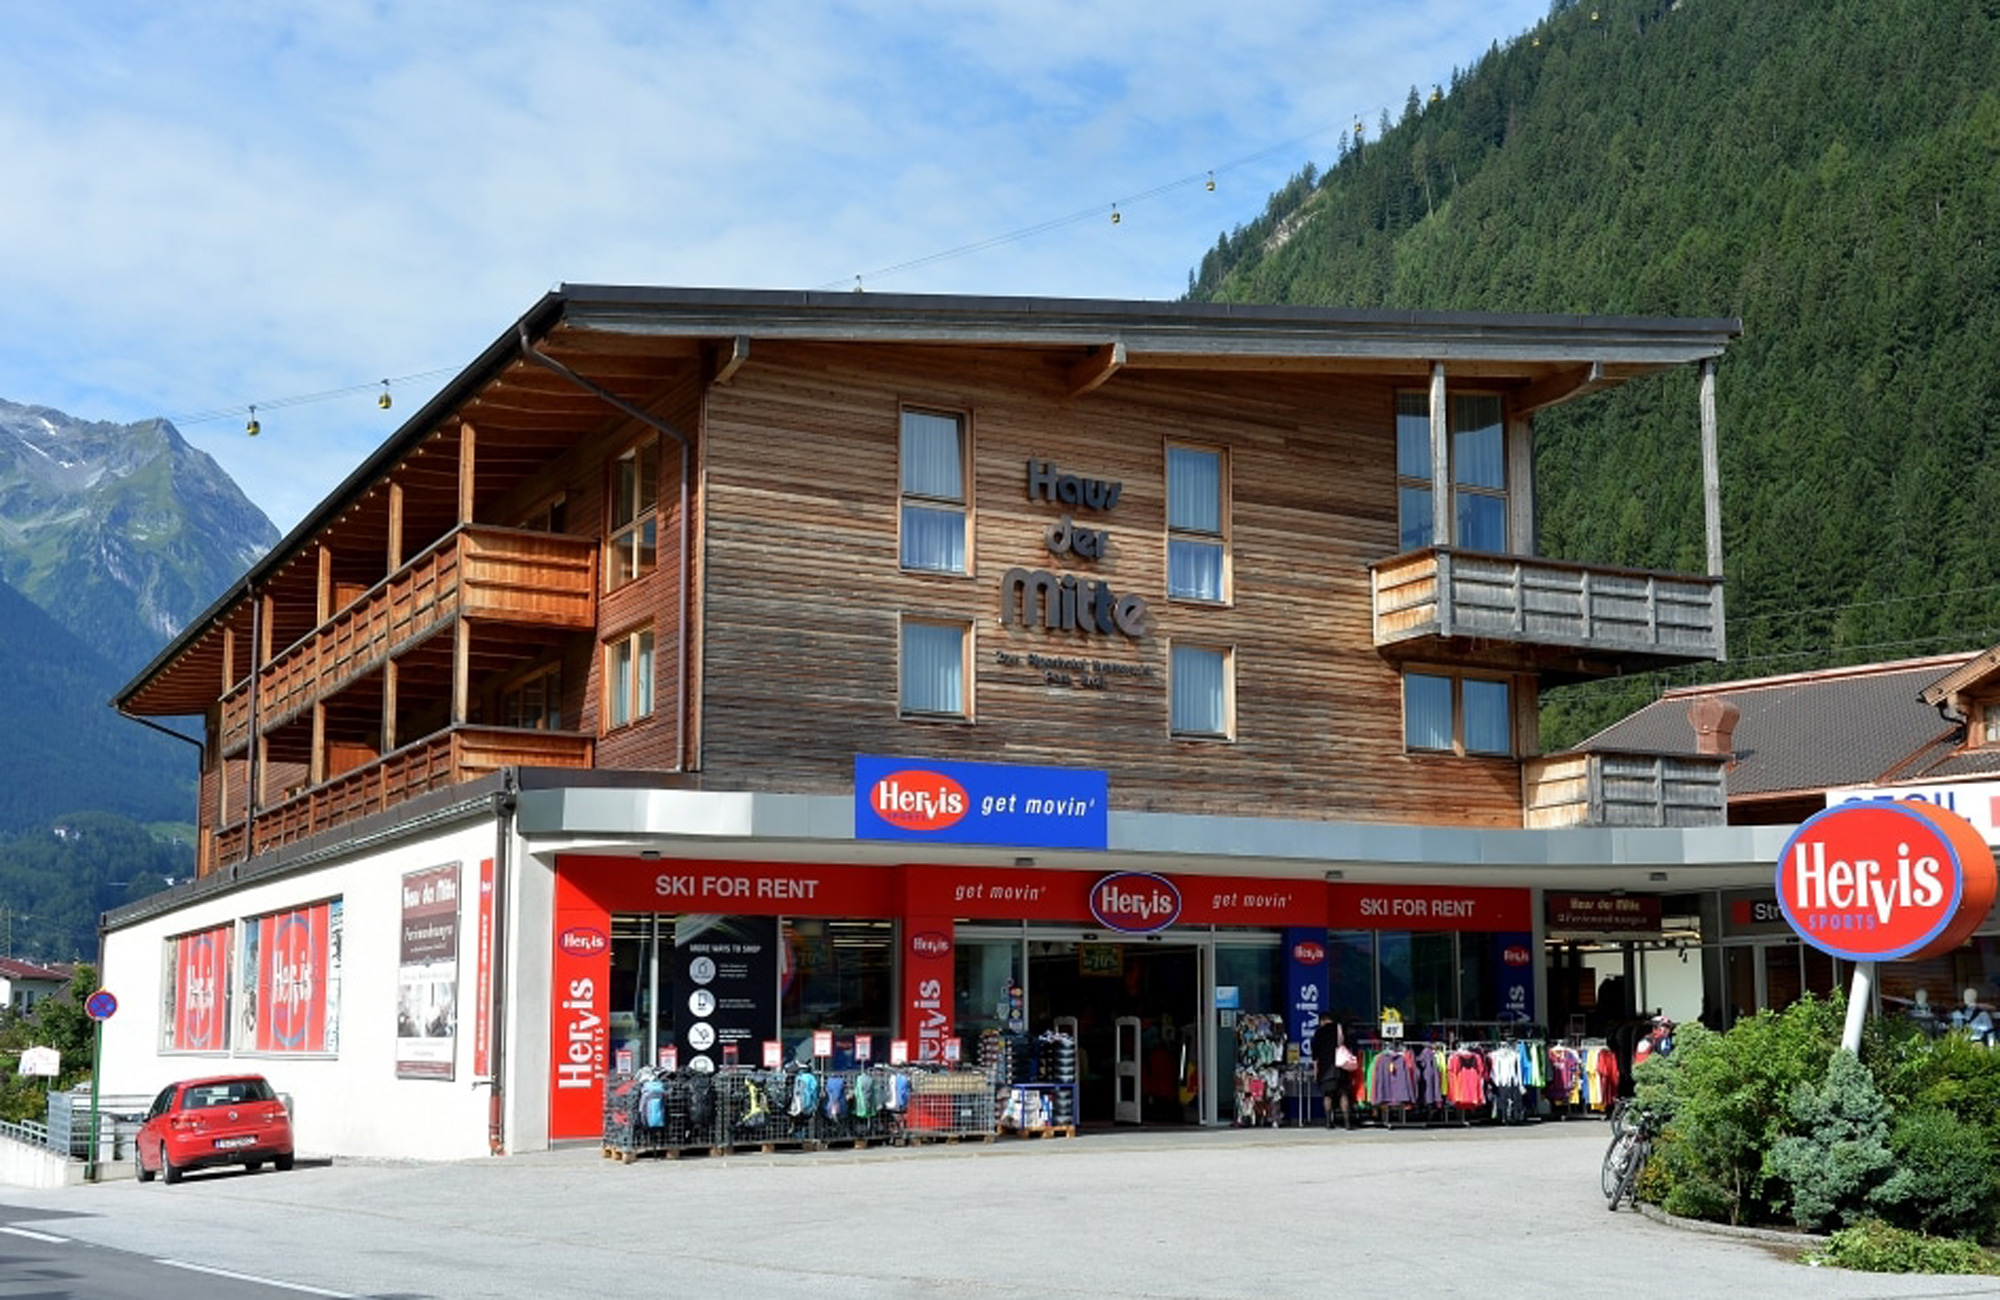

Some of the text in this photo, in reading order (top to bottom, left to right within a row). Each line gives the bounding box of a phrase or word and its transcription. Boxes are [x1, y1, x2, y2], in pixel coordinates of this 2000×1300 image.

[1027, 458, 1121, 509] Haus
[1045, 514, 1108, 560] der
[1001, 567, 1150, 638] Mitte
[879, 781, 963, 819] Hervis
[981, 794, 1017, 816] get
[656, 875, 819, 899] SKI FOR RENT
[955, 883, 983, 900] get
[1795, 842, 1943, 924] Hervis
[1102, 885, 1173, 919] Hervis
[1212, 893, 1237, 909] get
[1360, 898, 1475, 918] SKI FOR RENT
[1808, 914, 1876, 931] SPORTS
[562, 933, 605, 949] Hervis
[913, 937, 949, 953] Hervis
[558, 978, 601, 1088] Hervis
